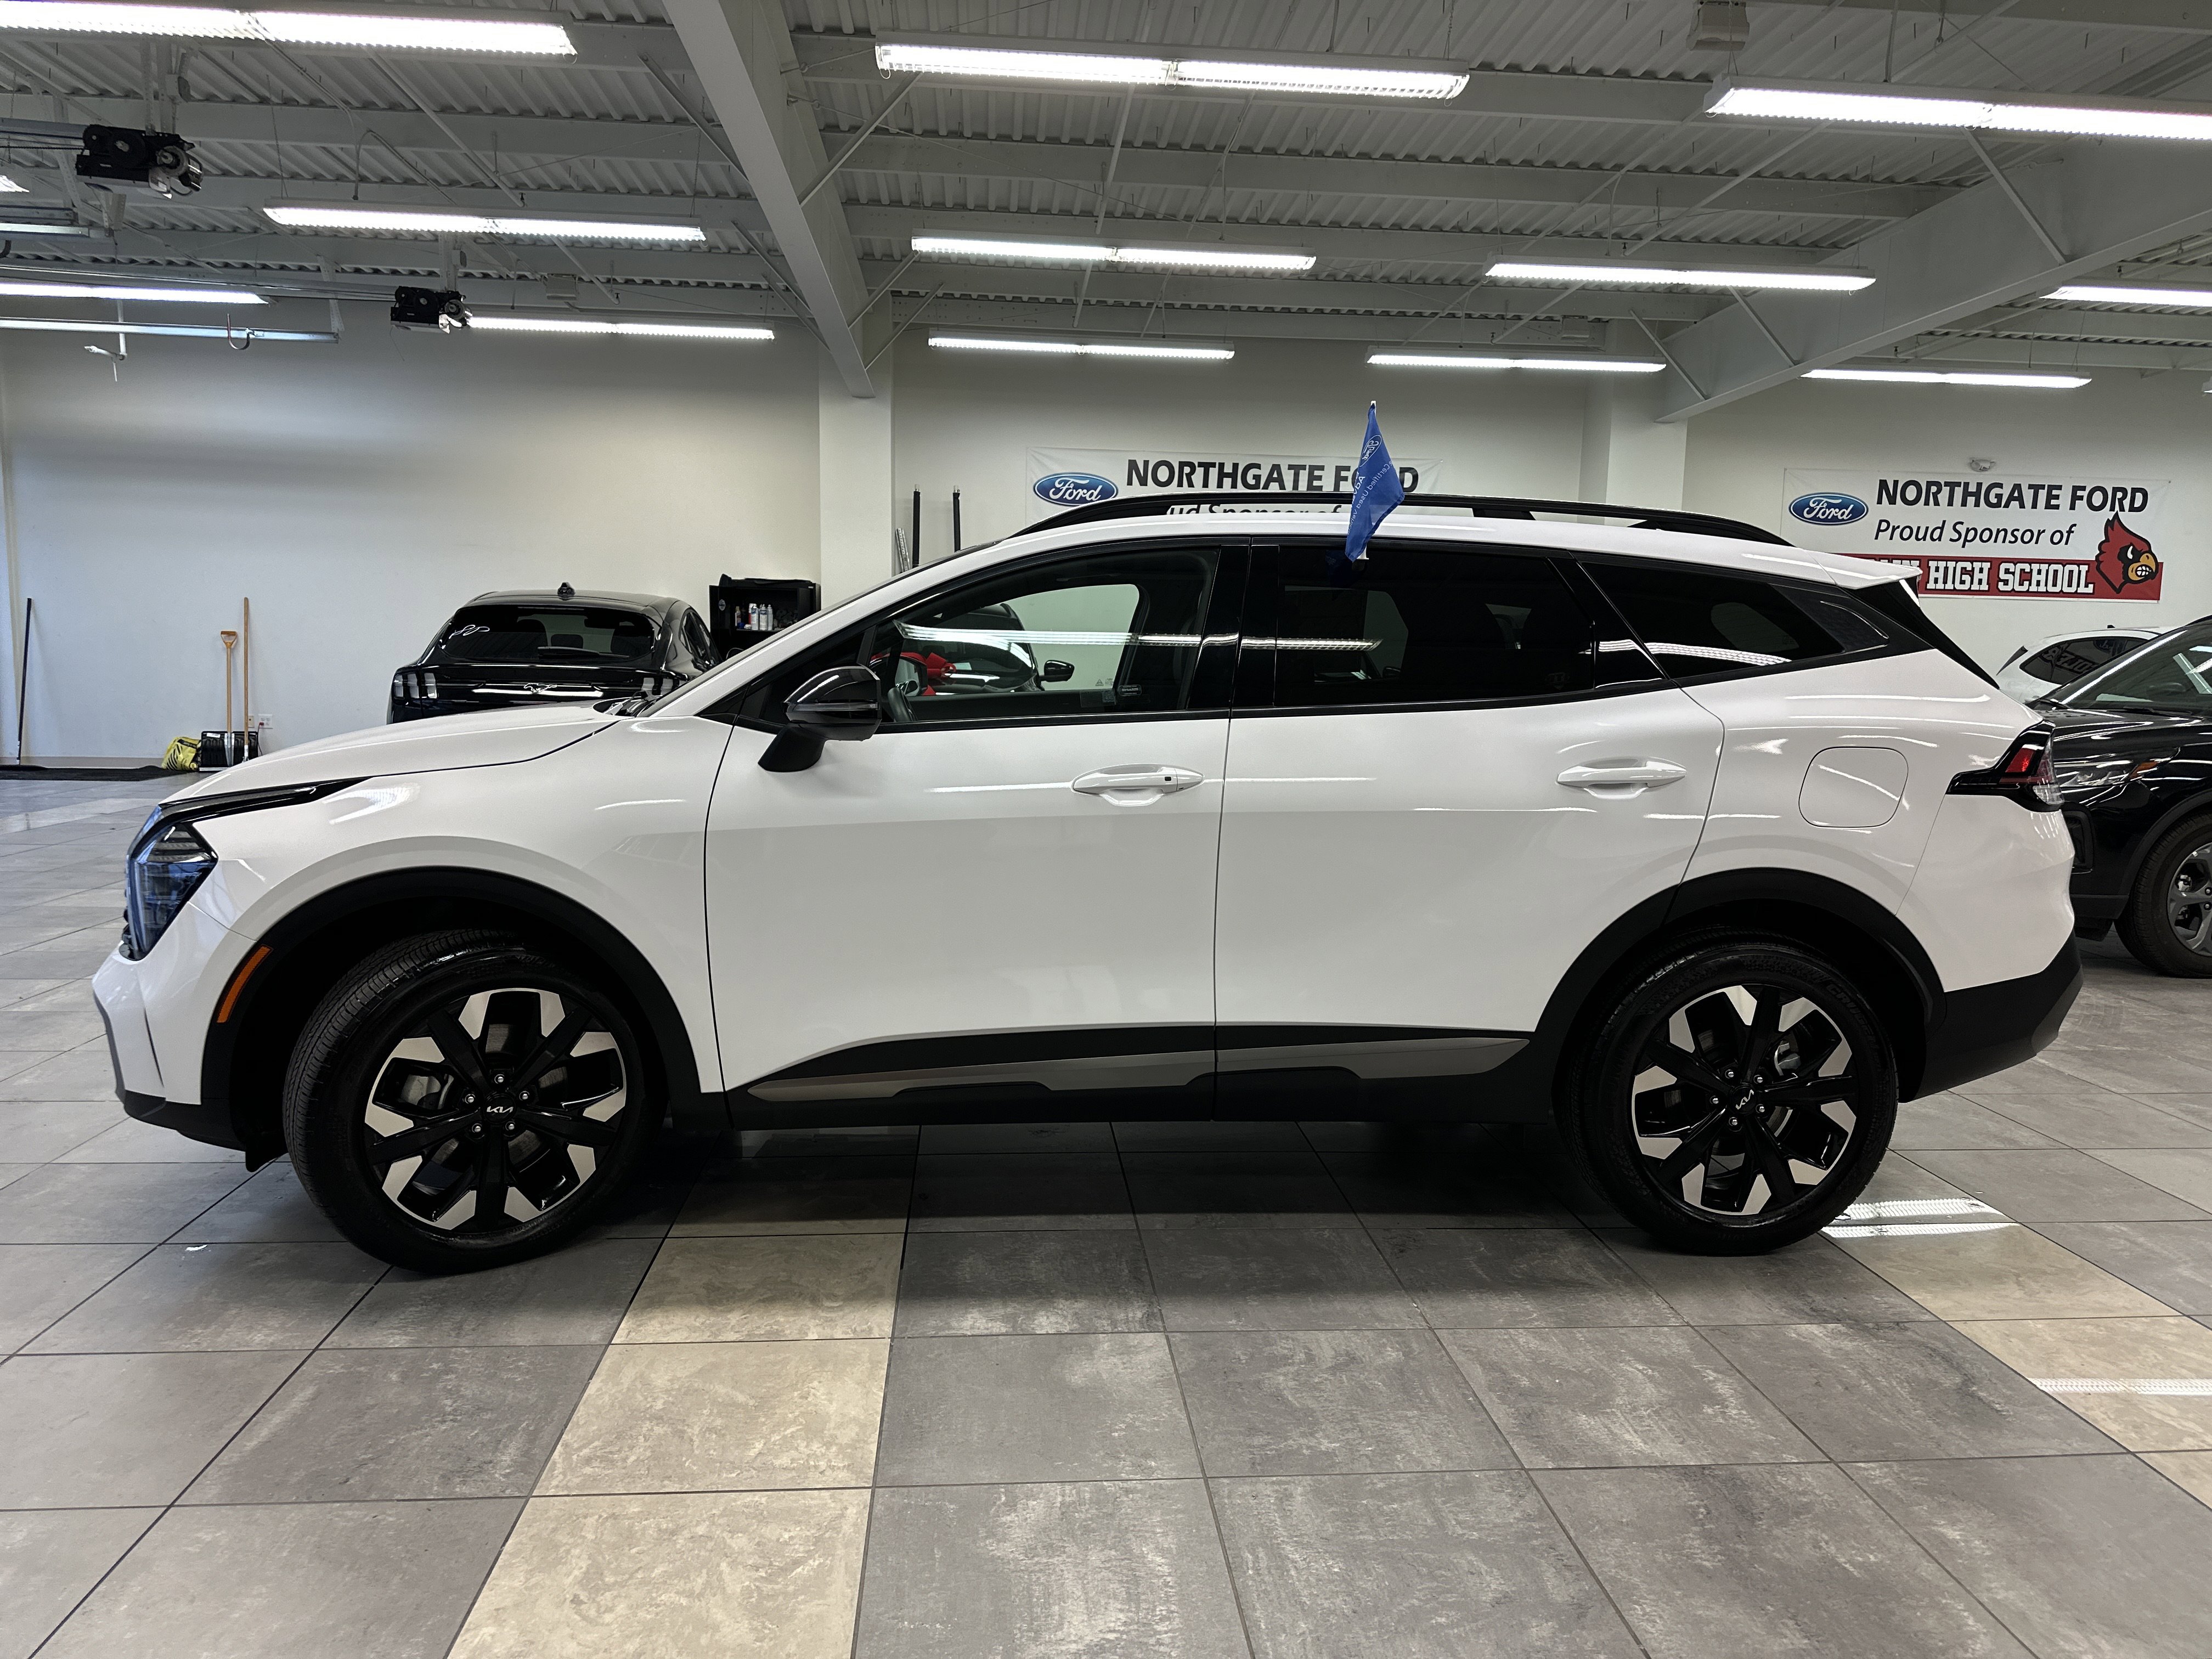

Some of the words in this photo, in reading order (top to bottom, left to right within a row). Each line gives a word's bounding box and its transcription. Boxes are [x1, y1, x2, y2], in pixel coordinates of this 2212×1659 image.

[1049, 477, 1103, 501] Ford
[1126, 459, 1325, 492] NORTHGATE
[1803, 497, 1854, 520] Ford
[1876, 479, 2063, 510] NORTHGATE
[2069, 485, 2149, 513] FORD
[1874, 519, 1946, 542] Proud
[1949, 521, 2046, 548] Sponsor
[2050, 523, 2077, 545] of
[1926, 560, 1991, 592] HIGH
[1997, 563, 2094, 594] SCHOOL
